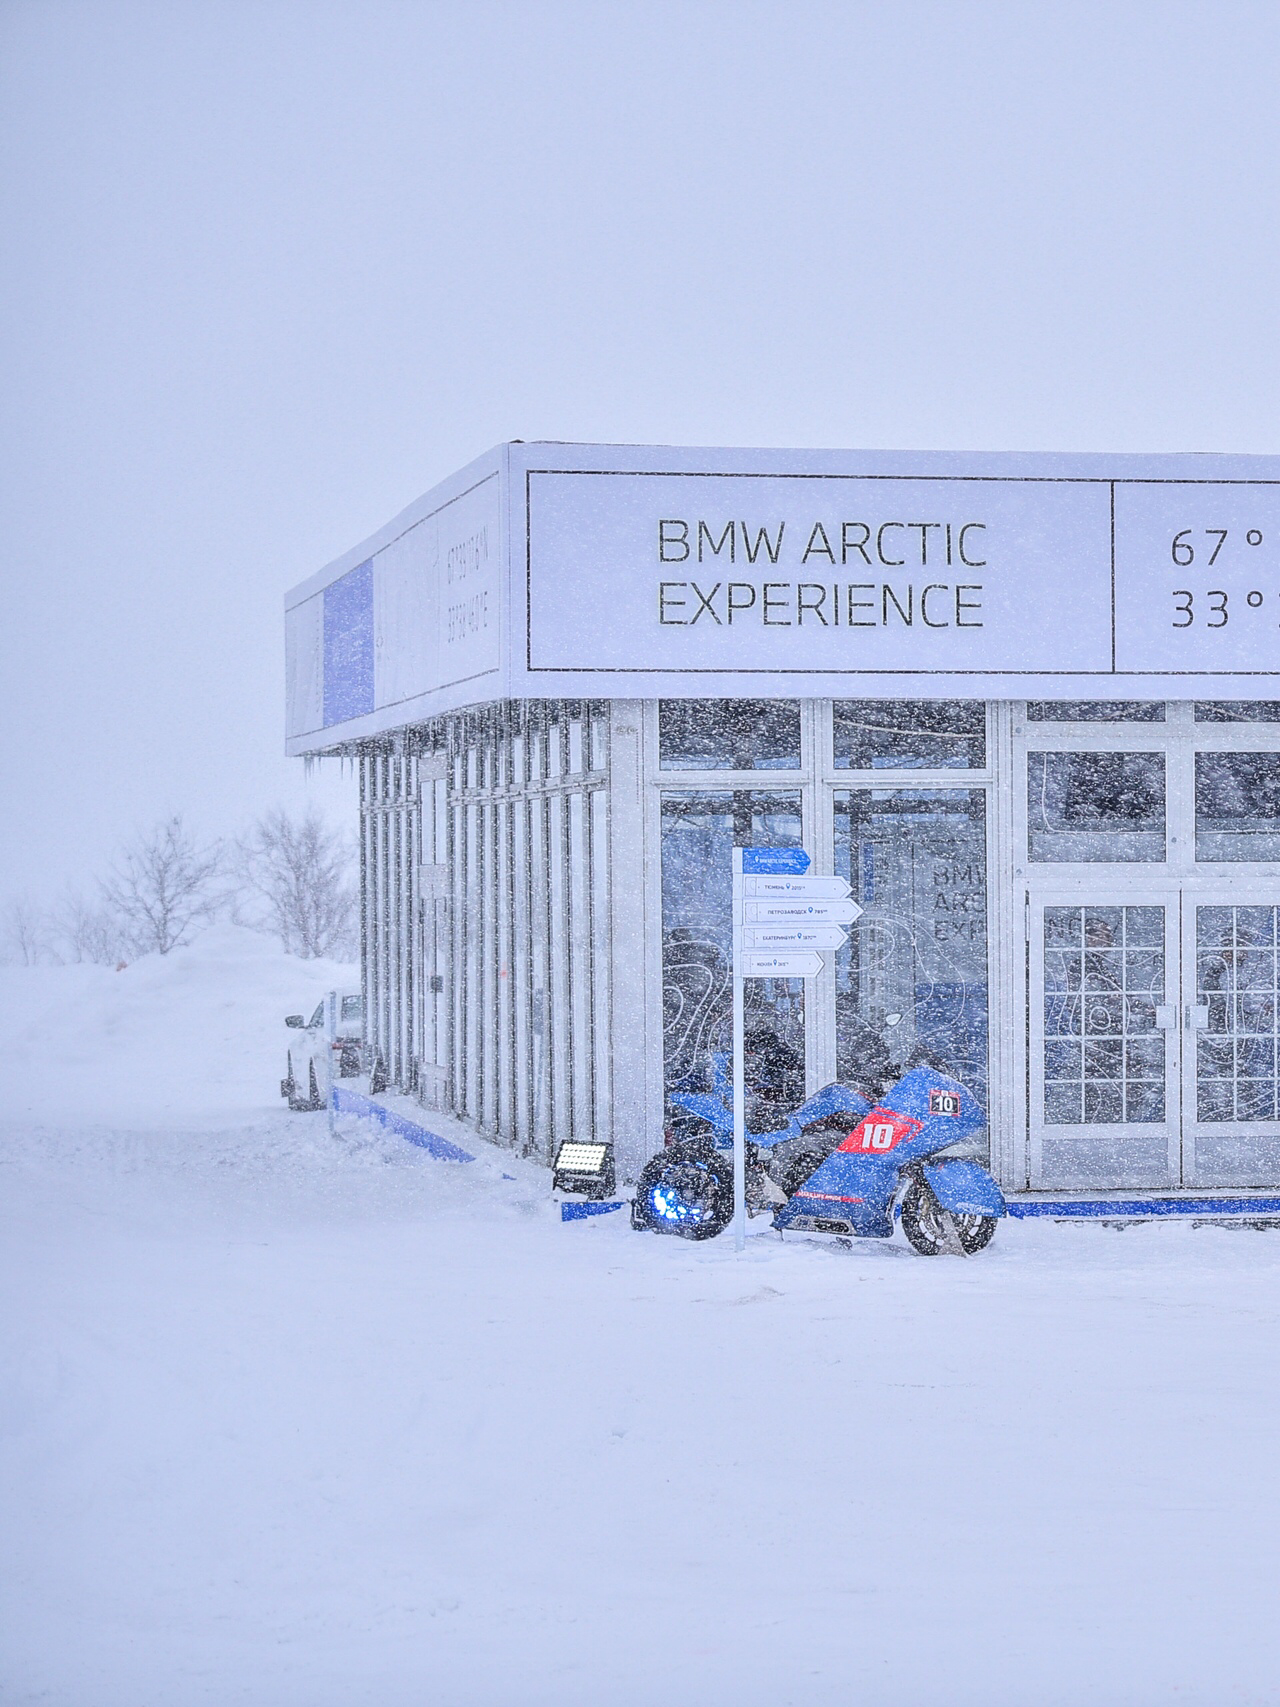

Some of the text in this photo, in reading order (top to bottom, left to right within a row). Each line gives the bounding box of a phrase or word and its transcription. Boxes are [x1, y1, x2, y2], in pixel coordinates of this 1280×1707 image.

[658, 519, 987, 567] BMW ARCTIC
[658, 581, 985, 628] EXPERIENCE
[934, 1095, 954, 1112] 10
[861, 1123, 894, 1149] 10
